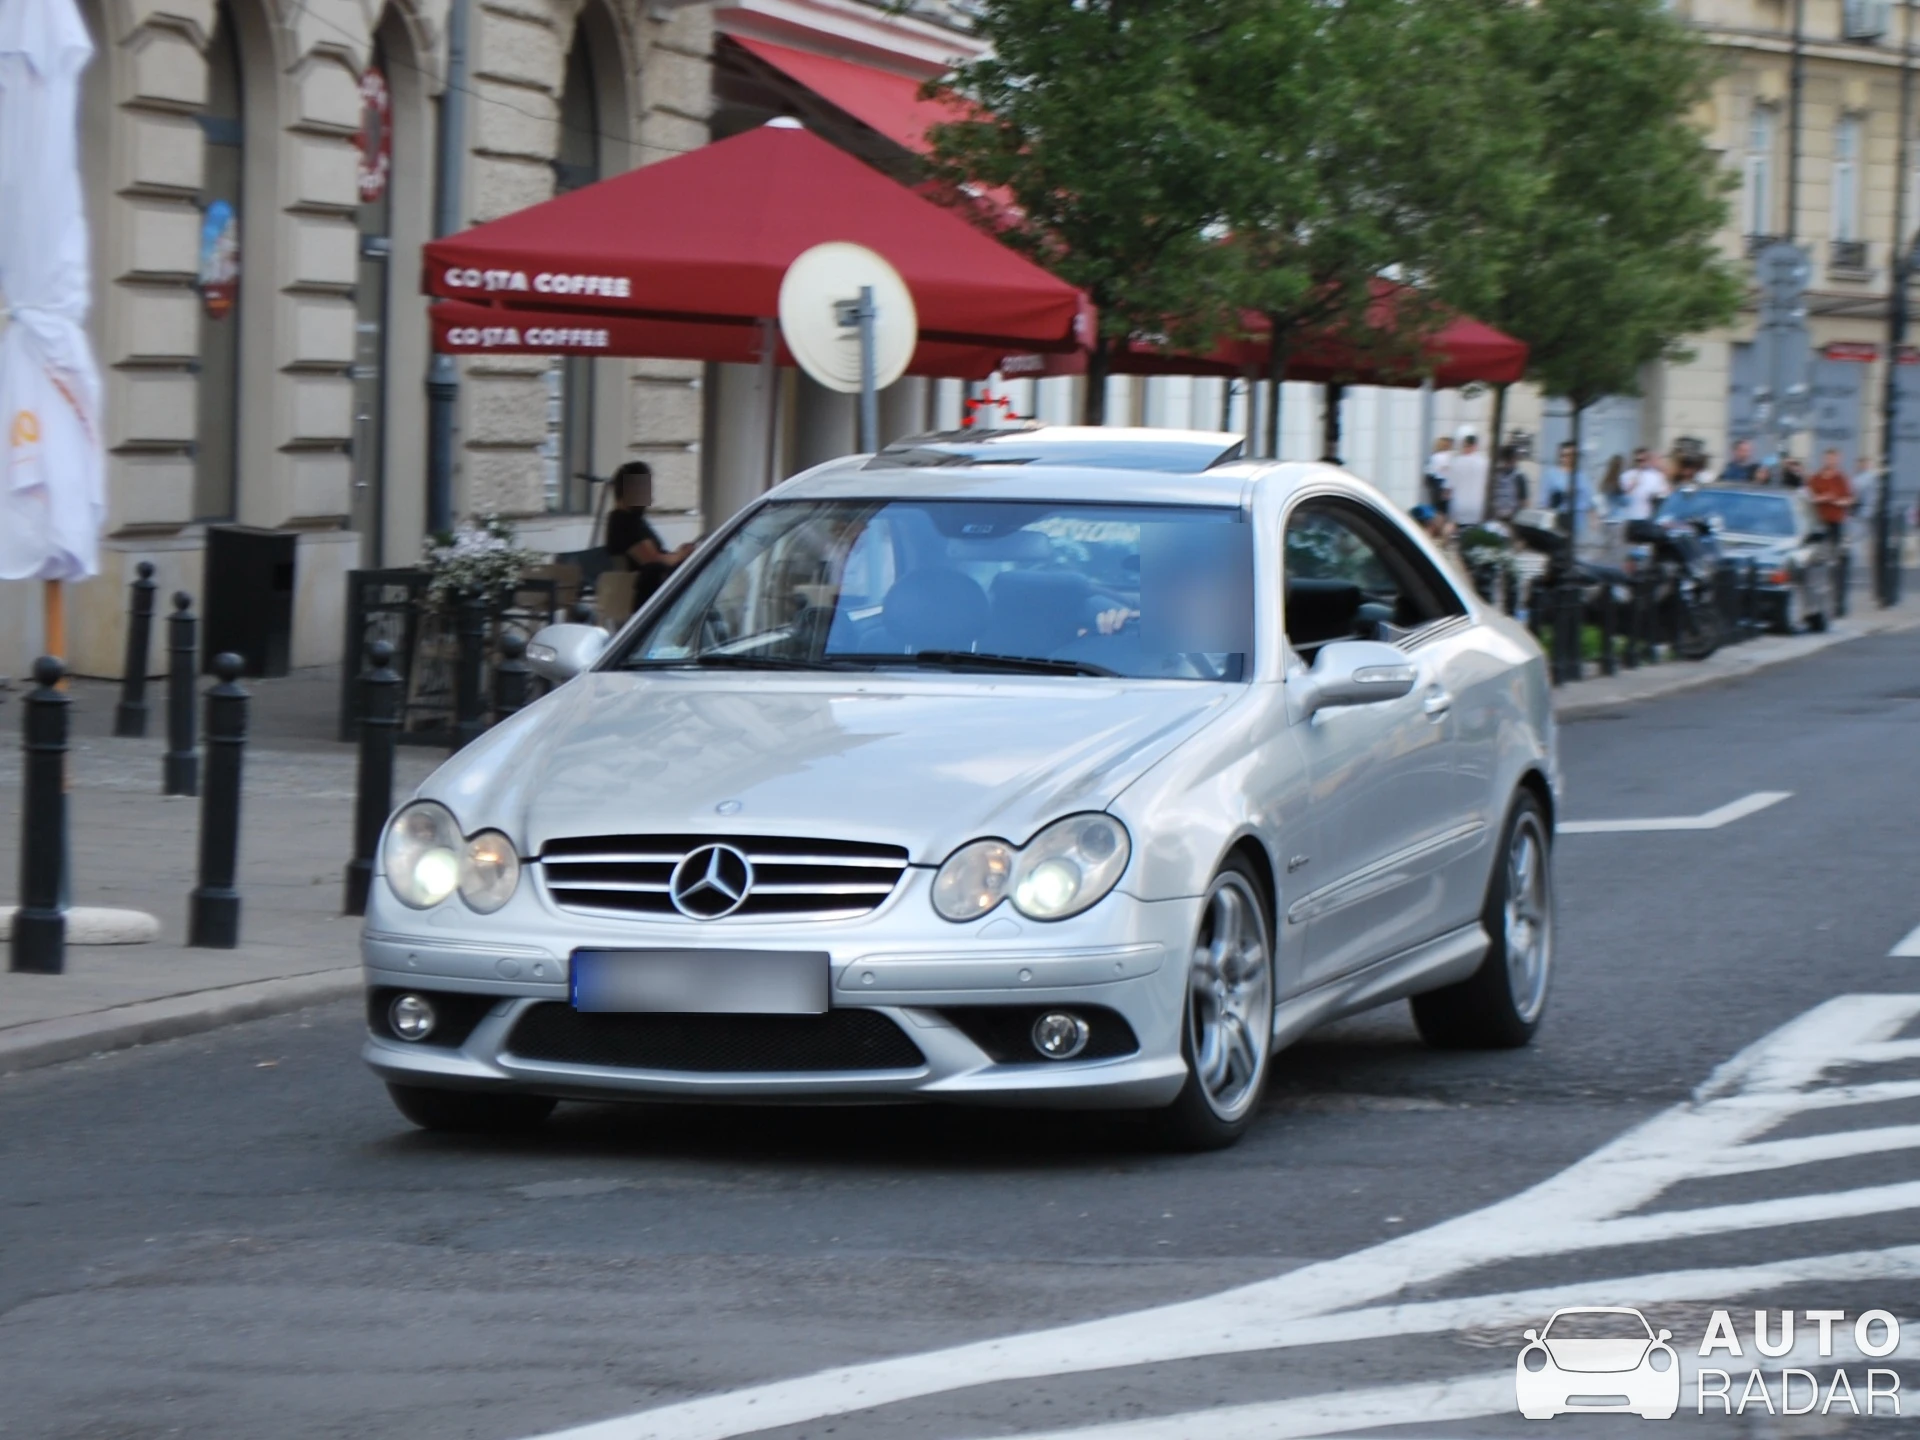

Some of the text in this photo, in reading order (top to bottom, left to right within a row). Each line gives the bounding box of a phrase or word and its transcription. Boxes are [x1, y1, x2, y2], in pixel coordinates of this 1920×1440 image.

[444, 268, 632, 298] COSTA COFFEE
[447, 327, 610, 348] COSTA COFFEE
